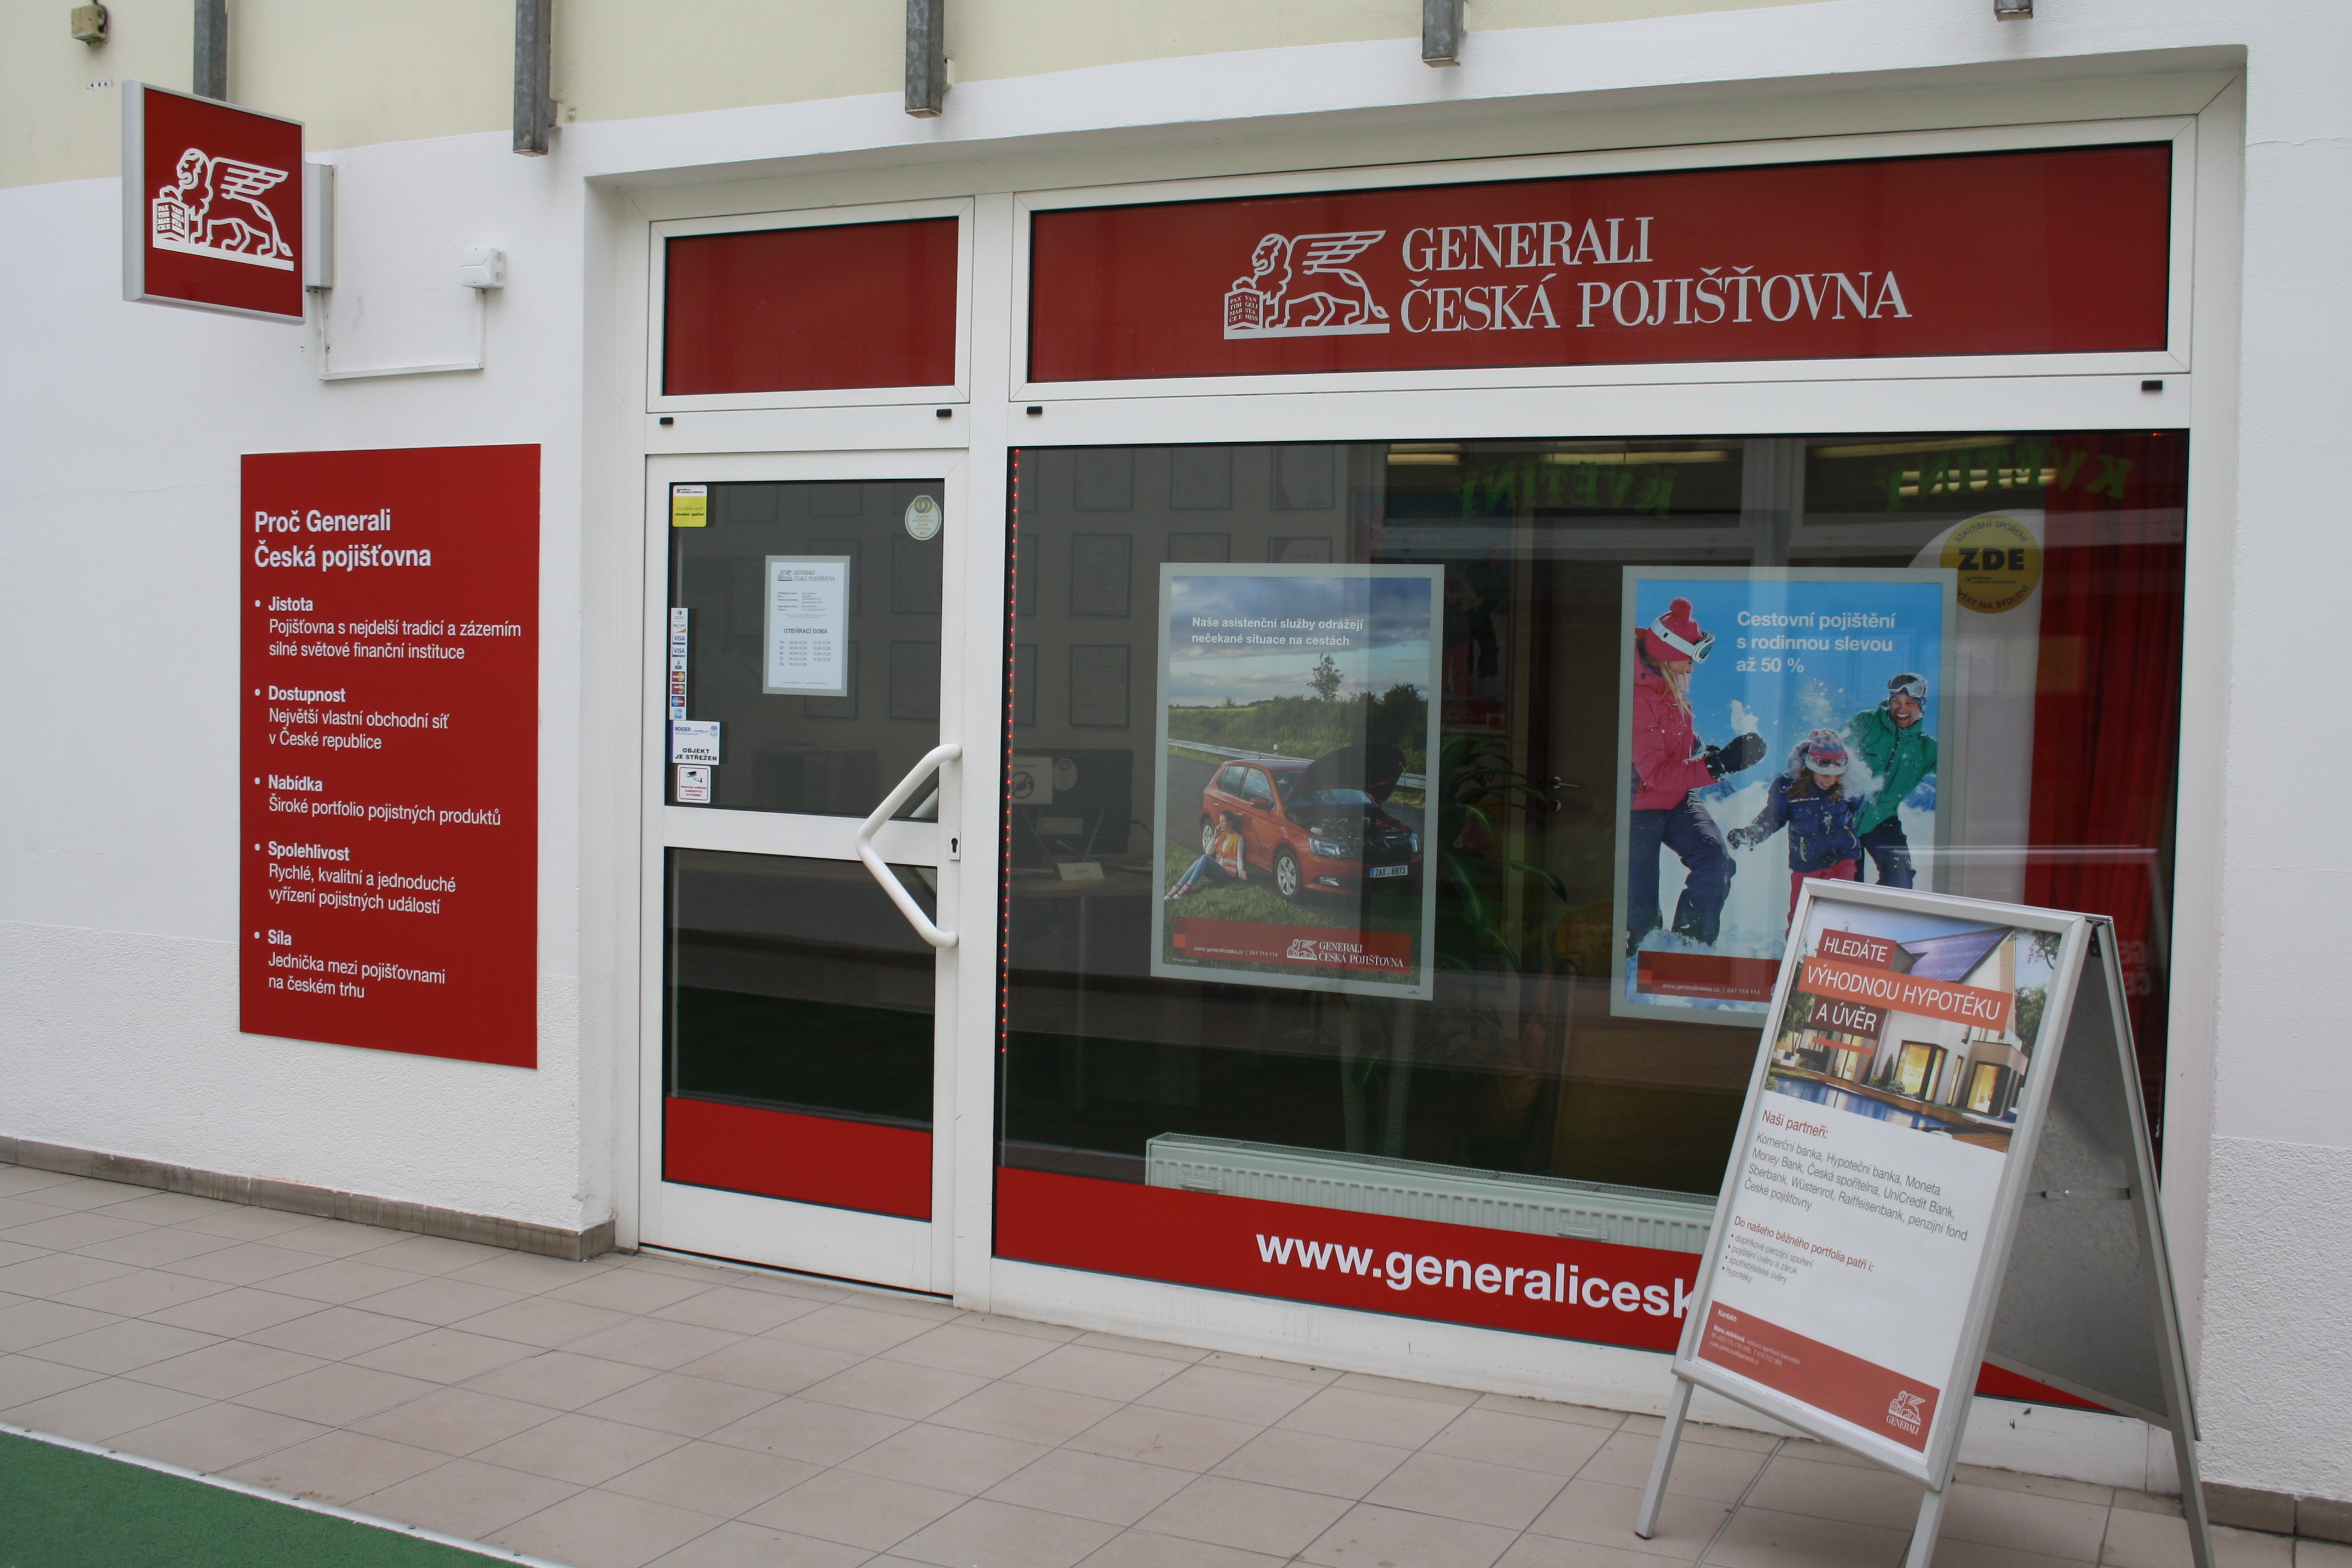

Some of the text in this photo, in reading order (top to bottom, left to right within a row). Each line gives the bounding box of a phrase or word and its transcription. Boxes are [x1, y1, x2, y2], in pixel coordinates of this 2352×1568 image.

[1402, 216, 1654, 273] GENERALI
[1400, 266, 1912, 334] ČESKÁ POJIŠŤOVNA
[255, 509, 391, 532] Proč Generali
[1955, 519, 2030, 543] STAVEBNÍ SPOŘENÍ
[255, 540, 431, 572] Česká pojišťovna
[1958, 548, 2025, 570] ZDE
[269, 597, 313, 611] Jistota
[269, 618, 521, 638] Pojišťovna s nejdelší tradicí a zázemím
[1192, 617, 1364, 631] Naše asistenční služby odrážejí
[1737, 611, 1895, 630] Cestovní pojištění
[269, 641, 465, 659] silné světové finanční instituce
[1192, 633, 1350, 646] nečekané situace na cestách
[1736, 635, 1893, 652] s rodinnou slevou
[1736, 658, 1804, 673] až 50 %
[269, 685, 345, 704] Dostupnost
[269, 708, 449, 728] Největší vlastní obchodní síť
[269, 727, 382, 751] v České republice
[268, 774, 322, 792] Nabídka
[269, 793, 501, 826] Široké portfolio pojistných produktů
[268, 841, 350, 861] Spolehlivost
[269, 863, 456, 893] Rychlé, kvalitní a jednoduché
[269, 886, 440, 914] vyřízení pojistných událostí
[268, 929, 292, 946] Síla
[1319, 941, 1363, 953] GENERALI
[1824, 936, 1888, 962] HLEDÁTE
[269, 952, 446, 985] Jednička mezi pojišťovnami
[1319, 951, 1403, 967] ČESKÁ POJIŠŤOVNA
[269, 975, 365, 998] na českém trhu
[1808, 964, 2002, 1021] VÝHODNOU HYPOTÉKU
[1816, 1002, 1877, 1032] A ÚVĚR
[1762, 1109, 1828, 1140] Naši partneři:
[1756, 1132, 1941, 1196] Komerční banka, Hypoteční banka, Moneta
[1744, 1176, 1812, 1212] České pojišťovny
[1753, 1148, 1955, 1220] Money Bank, Česká spořitelna, UniCredit Bank,
[1748, 1163, 1968, 1241] Sberbank, Wüstenrot, Raiffeisenbank, penzijní fond
[1734, 1215, 1745, 1227] Do
[1746, 1221, 1774, 1238] našeho
[1775, 1229, 1809, 1250] běžného
[1811, 1244, 1845, 1262] portfolia
[1846, 1256, 1867, 1269] patří
[1735, 1235, 1814, 1268] doplňkové penzijní spoření
[1725, 1266, 1753, 1284] hypotéky
[1757, 1253, 1774, 1266] úvěru
[1780, 1263, 1797, 1275] záruk
[1770, 1270, 1788, 1284] úvěry
[1886, 1415, 1919, 1435] GENERALI
